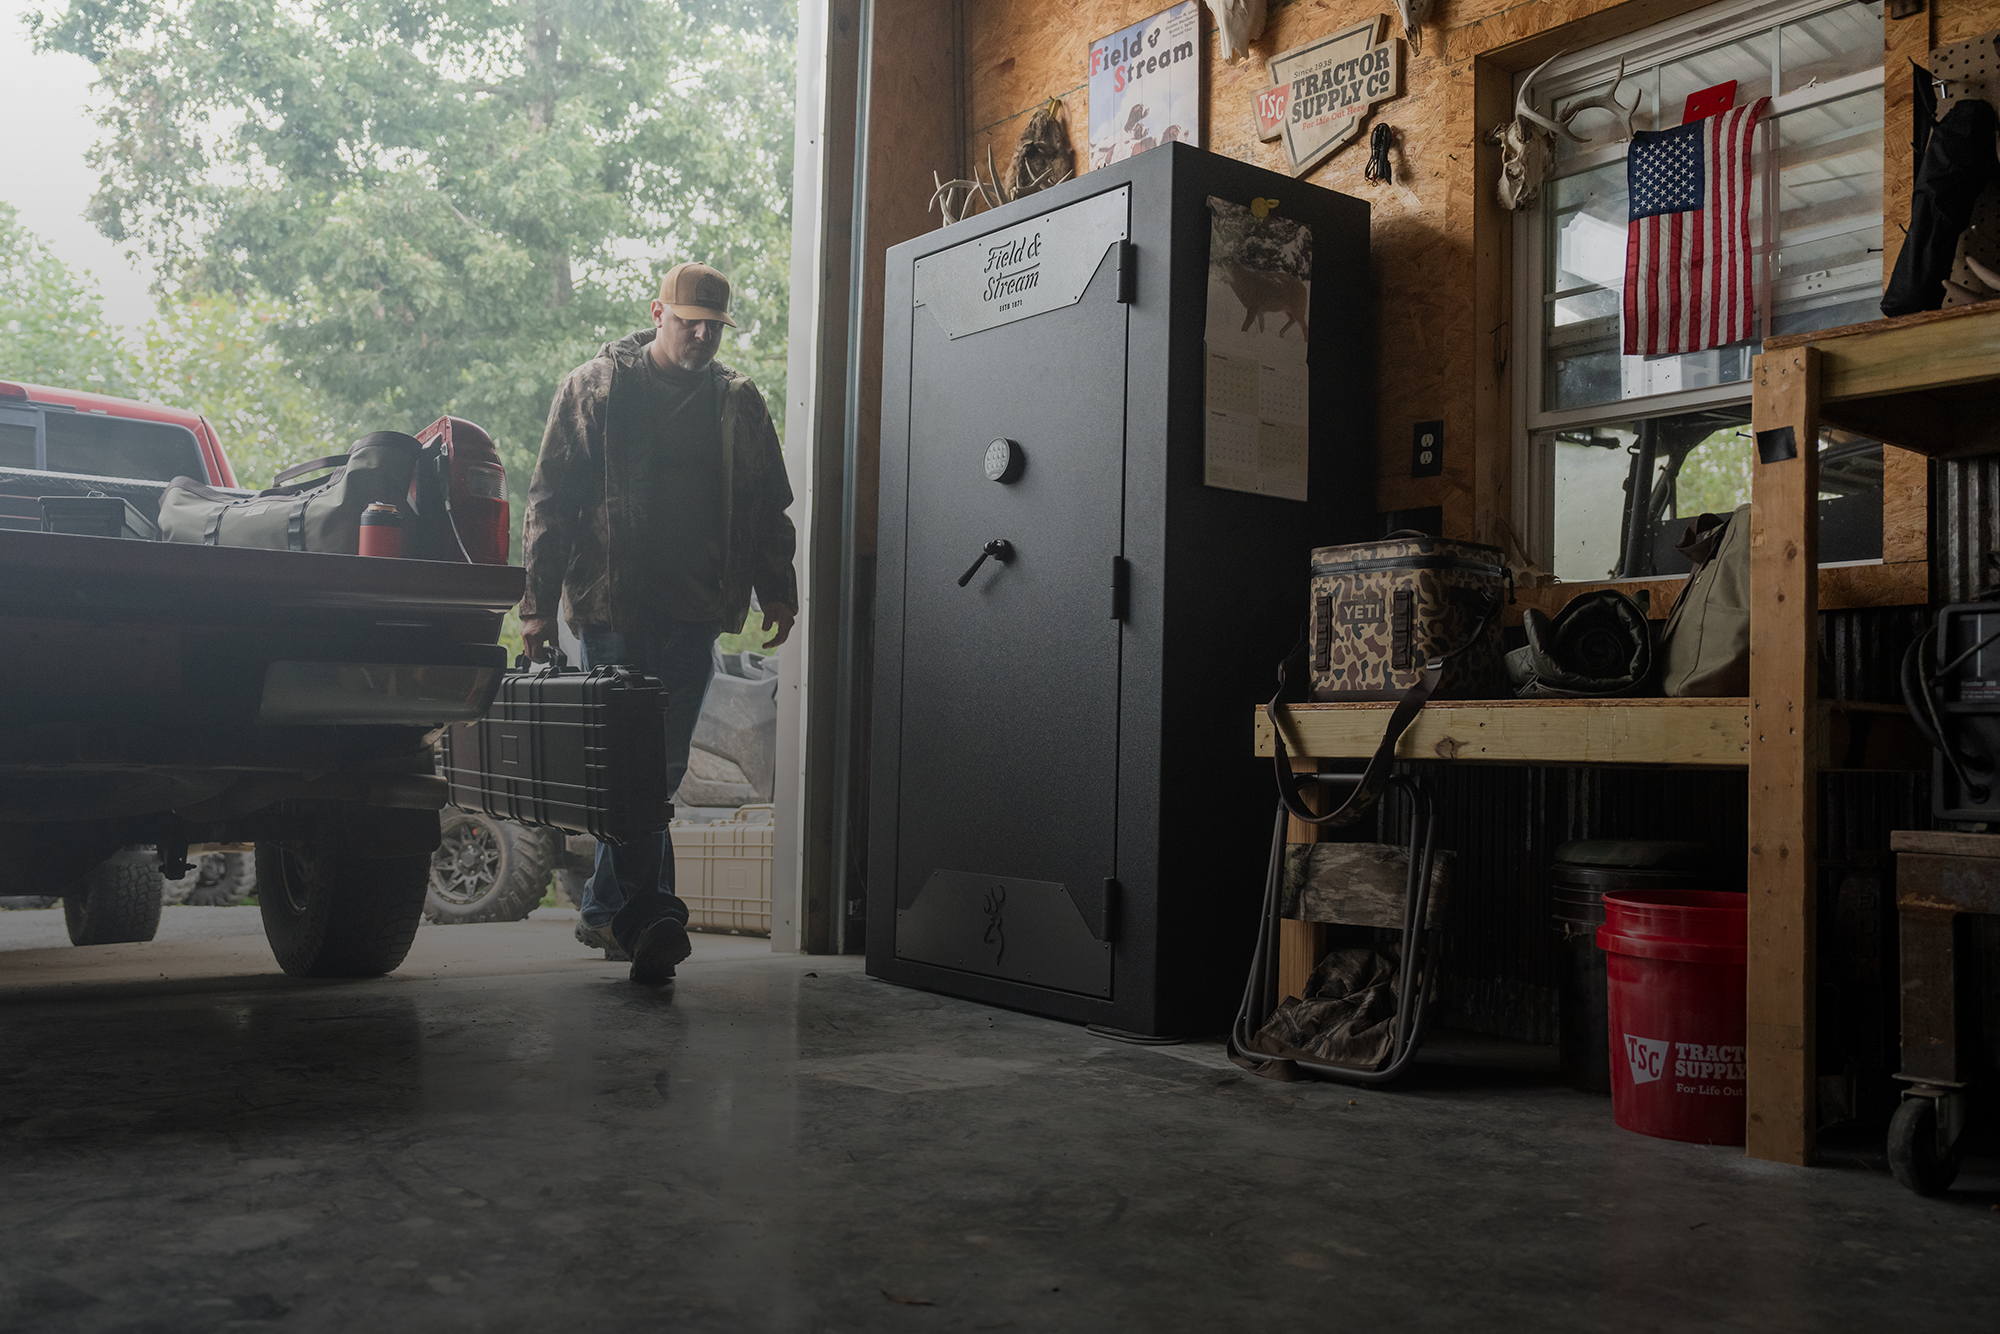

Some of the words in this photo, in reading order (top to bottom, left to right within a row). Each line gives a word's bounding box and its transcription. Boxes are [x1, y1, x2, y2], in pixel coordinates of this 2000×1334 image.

[1090, 30, 1143, 77] Field
[1147, 27, 1161, 48] &
[1115, 40, 1194, 93] Stream
[1293, 66, 1313, 79] Since
[1314, 58, 1333, 71] 1938
[1292, 47, 1390, 101] TRACTOR
[1259, 93, 1284, 121] TSC
[1291, 79, 1364, 125] SUPPLY
[1302, 121, 1315, 131] For
[1315, 116, 1330, 126] Life
[1331, 111, 1345, 121] Out
[1347, 103, 1366, 116] Here
[983, 236, 1027, 274] Field
[1027, 232, 1042, 259] &
[983, 264, 1040, 302] Stream
[1343, 603, 1380, 620] YETI
[1628, 1036, 1660, 1078] TSC
[1675, 1042, 1746, 1062] TRACT
[1675, 1059, 1746, 1080] SUPPLY
[1676, 1083, 1697, 1094] For
[1698, 1085, 1721, 1096] Life
[1722, 1086, 1744, 1096] Out
